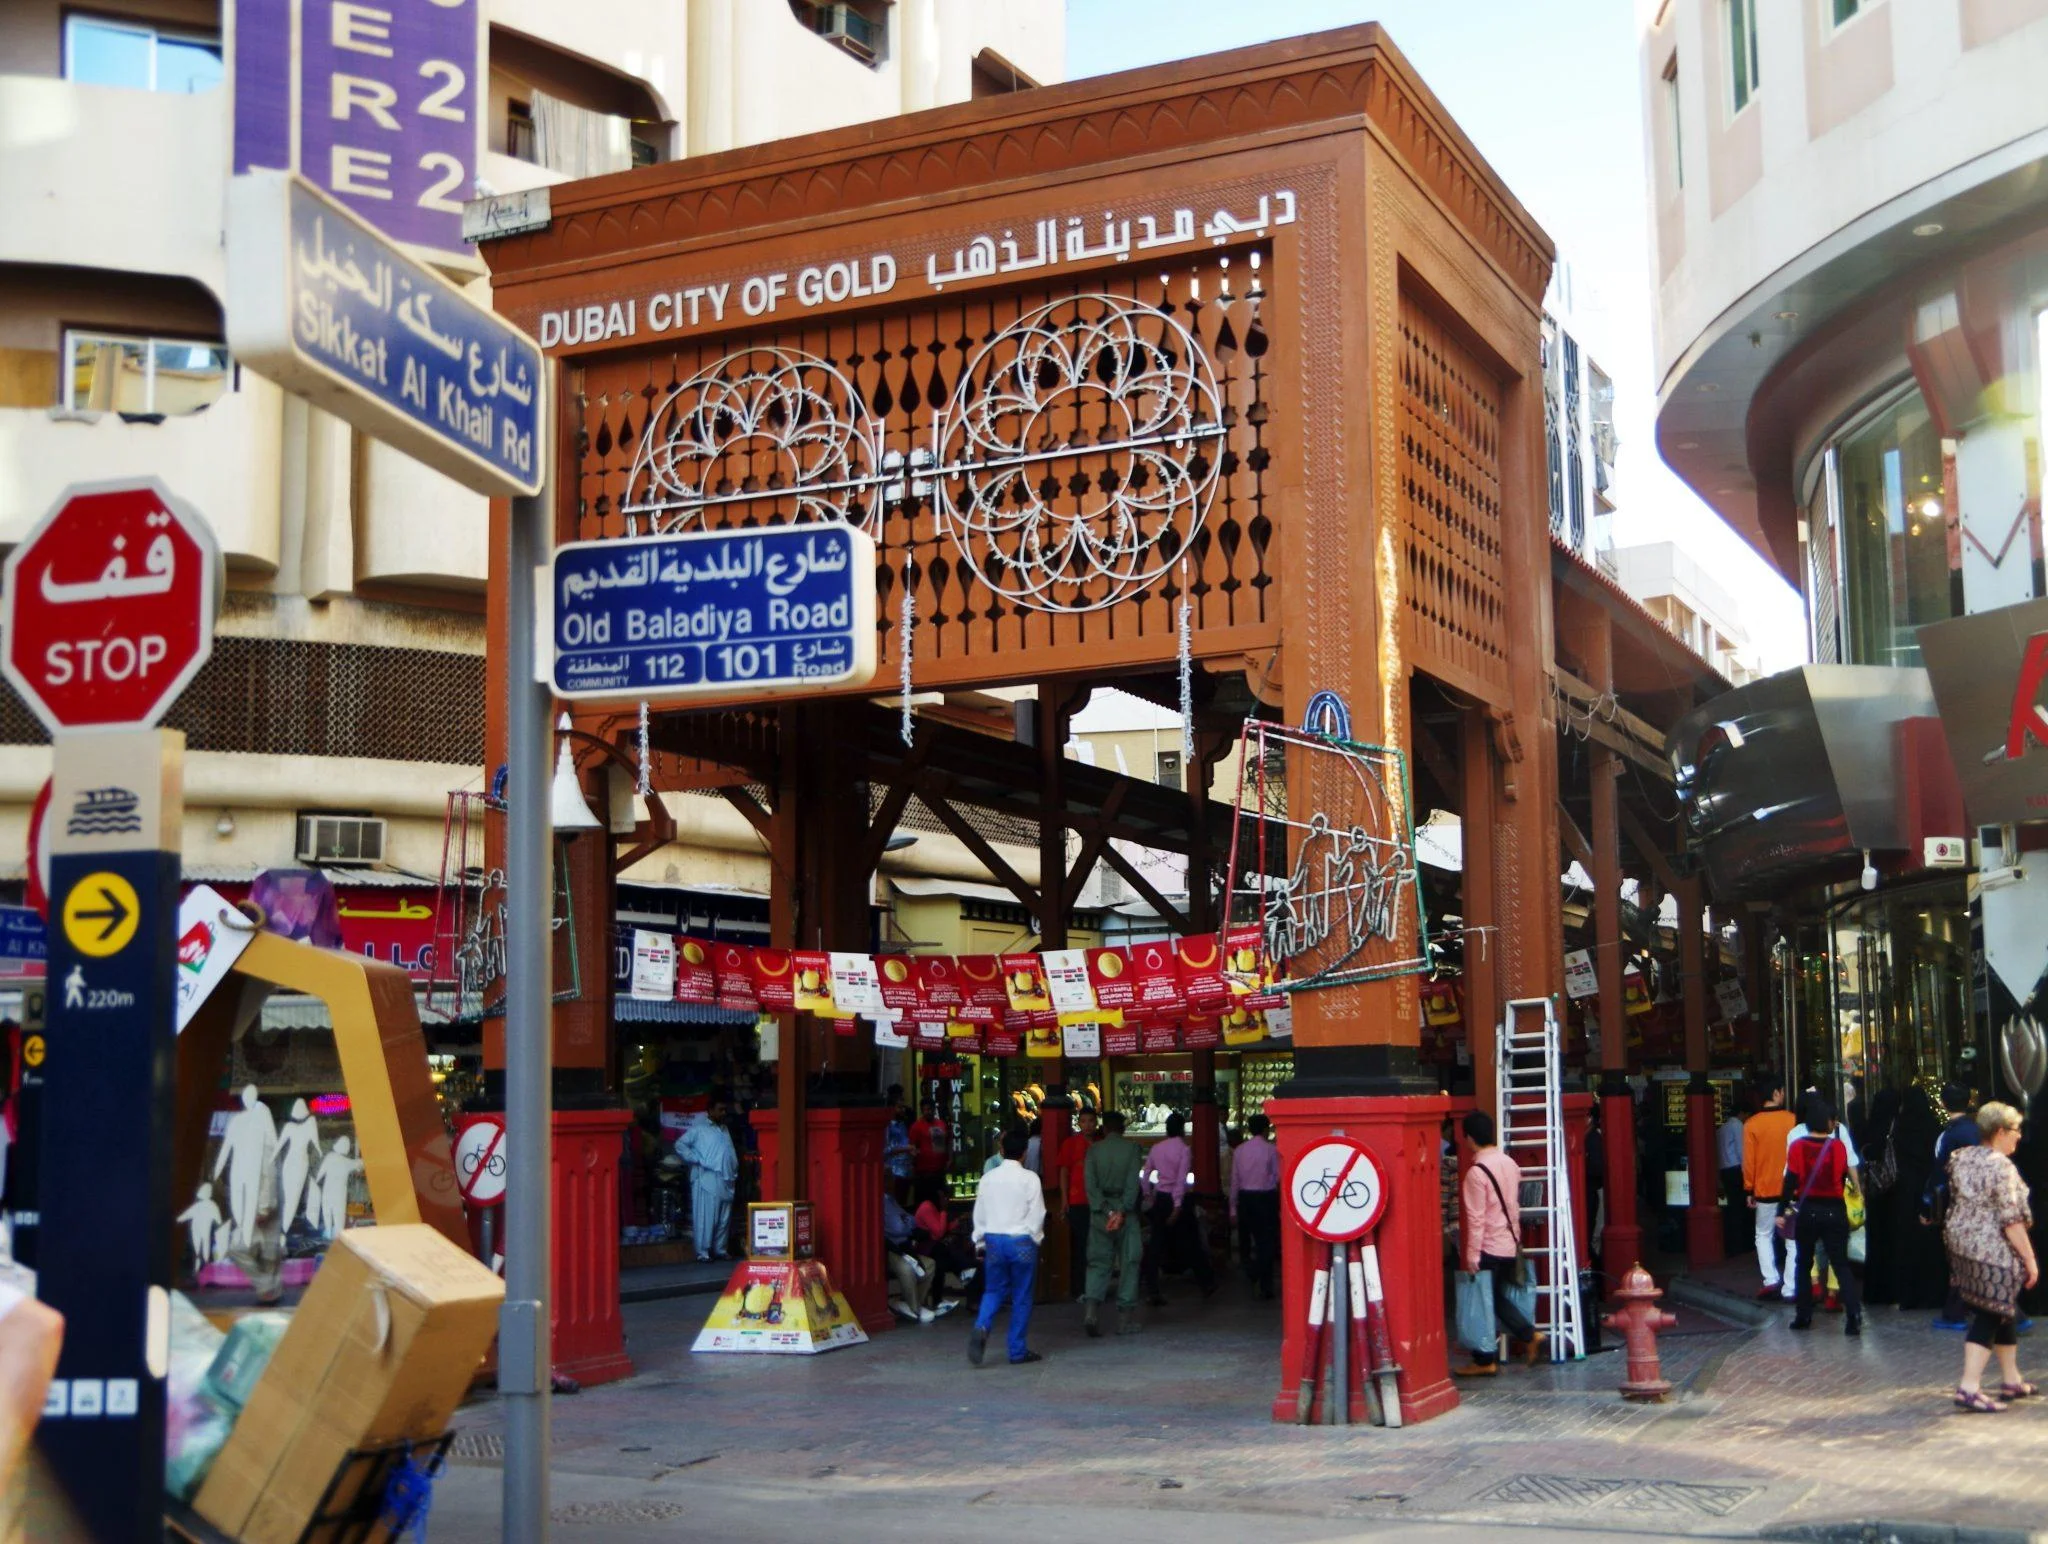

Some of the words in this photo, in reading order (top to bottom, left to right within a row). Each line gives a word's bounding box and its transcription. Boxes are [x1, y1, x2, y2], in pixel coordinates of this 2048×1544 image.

[1066, 208, 1194, 262] مدينة
[1204, 189, 1297, 246] دبي
[299, 216, 392, 313] الخيل
[927, 218, 1058, 292] الذهب
[397, 277, 463, 361] سكة
[540, 300, 636, 349] DUBAI
[648, 283, 730, 333] CITY
[742, 273, 788, 316] OF
[798, 254, 897, 306] GOLD
[299, 289, 388, 386] Sikkat
[401, 356, 427, 409] Al
[438, 376, 494, 449] Khail
[503, 417, 531, 472] Rd
[468, 341, 531, 405] شارع
[41, 510, 176, 604] قف
[563, 546, 660, 608] القديم
[659, 537, 763, 593] البلدية
[765, 536, 847, 595] شارع
[563, 611, 611, 646] Old
[626, 603, 753, 642] Baladiya
[769, 594, 848, 632] Road
[45, 635, 168, 686] STOP
[567, 653, 630, 674] المنطقة
[645, 653, 685, 680] 112
[717, 643, 776, 679] 101
[793, 639, 845, 662] شارع
[793, 660, 846, 677] Road
[567, 676, 629, 690] COMMUNITY
[87, 989, 134, 1008] 220m
[1133, 1073, 1165, 1082] DUBAI
